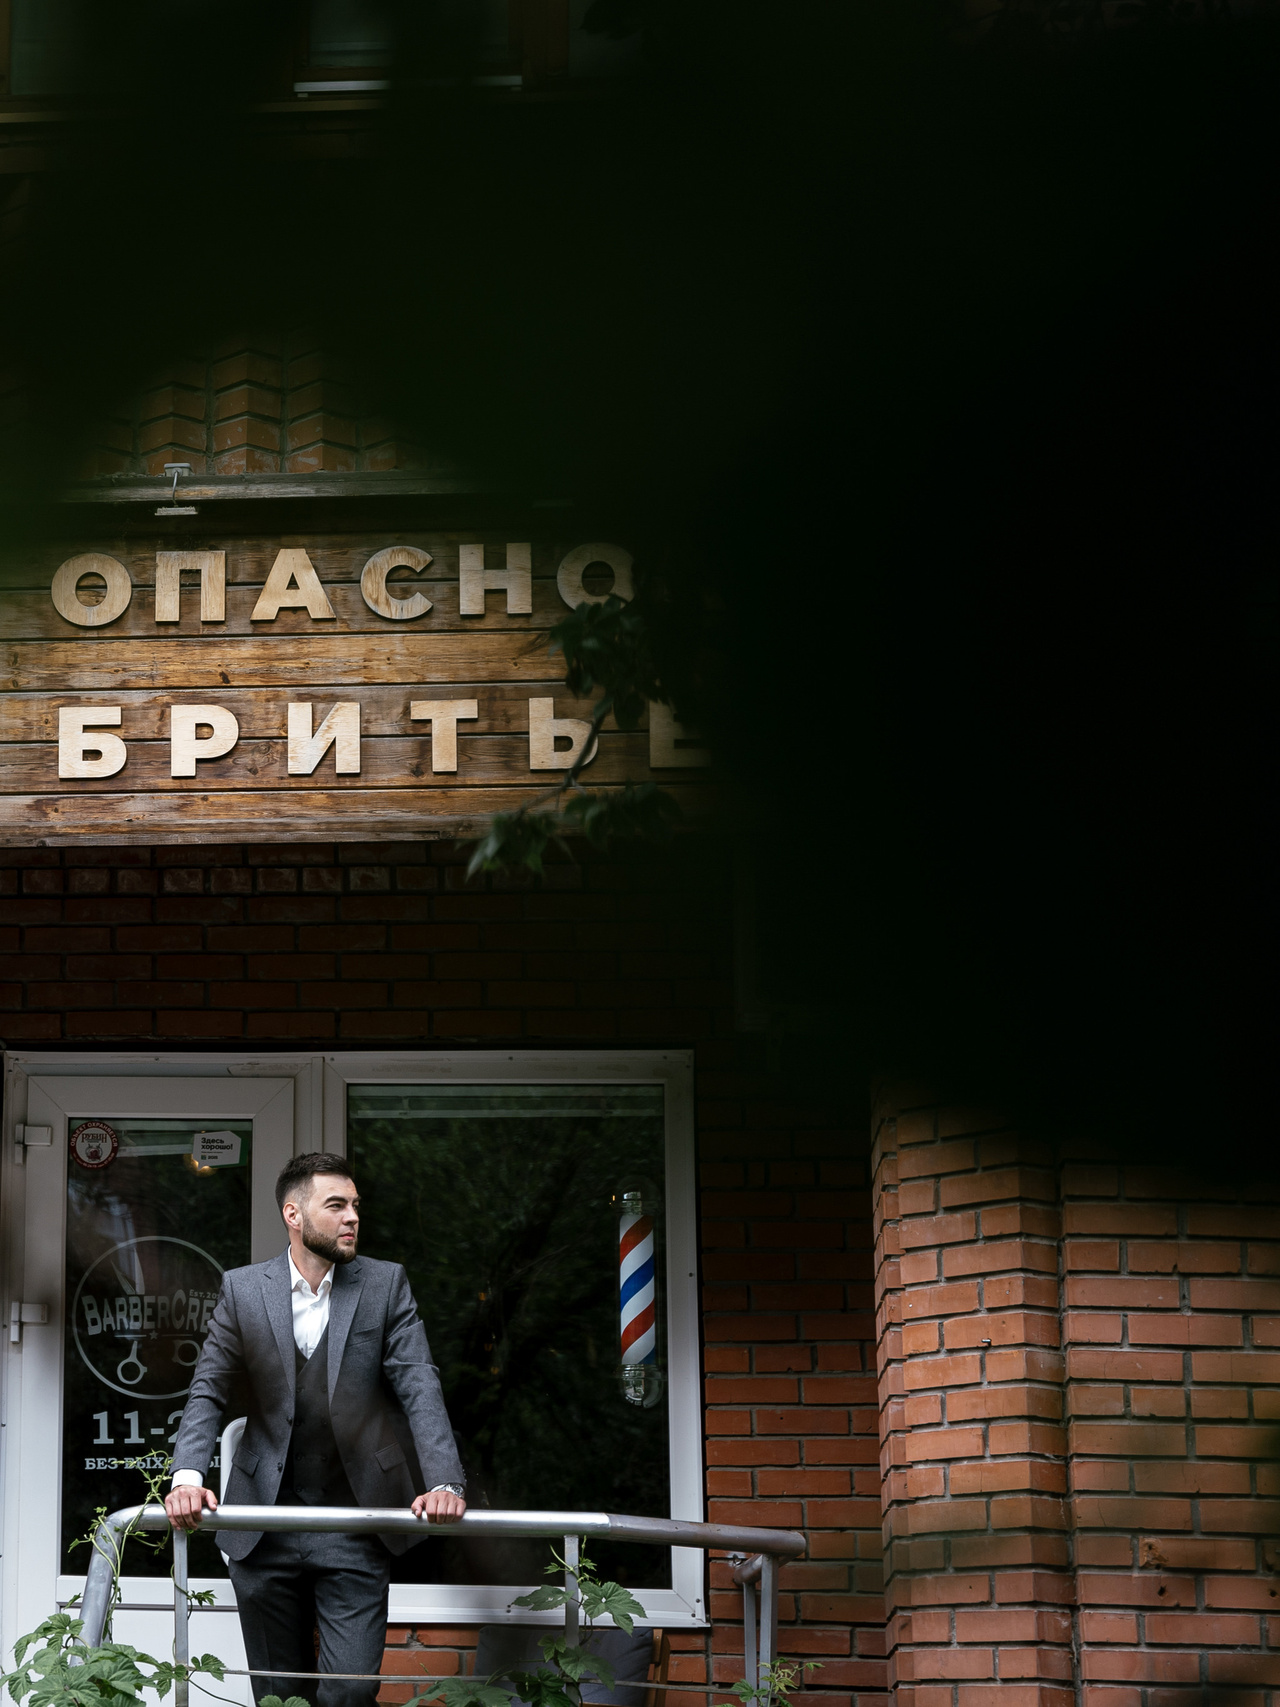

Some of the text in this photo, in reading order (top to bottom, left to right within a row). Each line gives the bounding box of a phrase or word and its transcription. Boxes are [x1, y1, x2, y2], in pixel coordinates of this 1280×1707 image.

[51, 542, 635, 627] ОПАСНО
[70, 1124, 86, 1147] ОБЪЕКТ
[201, 1137, 225, 1145] Здесь
[201, 1143, 233, 1151] хорошо!
[81, 1289, 216, 1336] BARBERCRE
